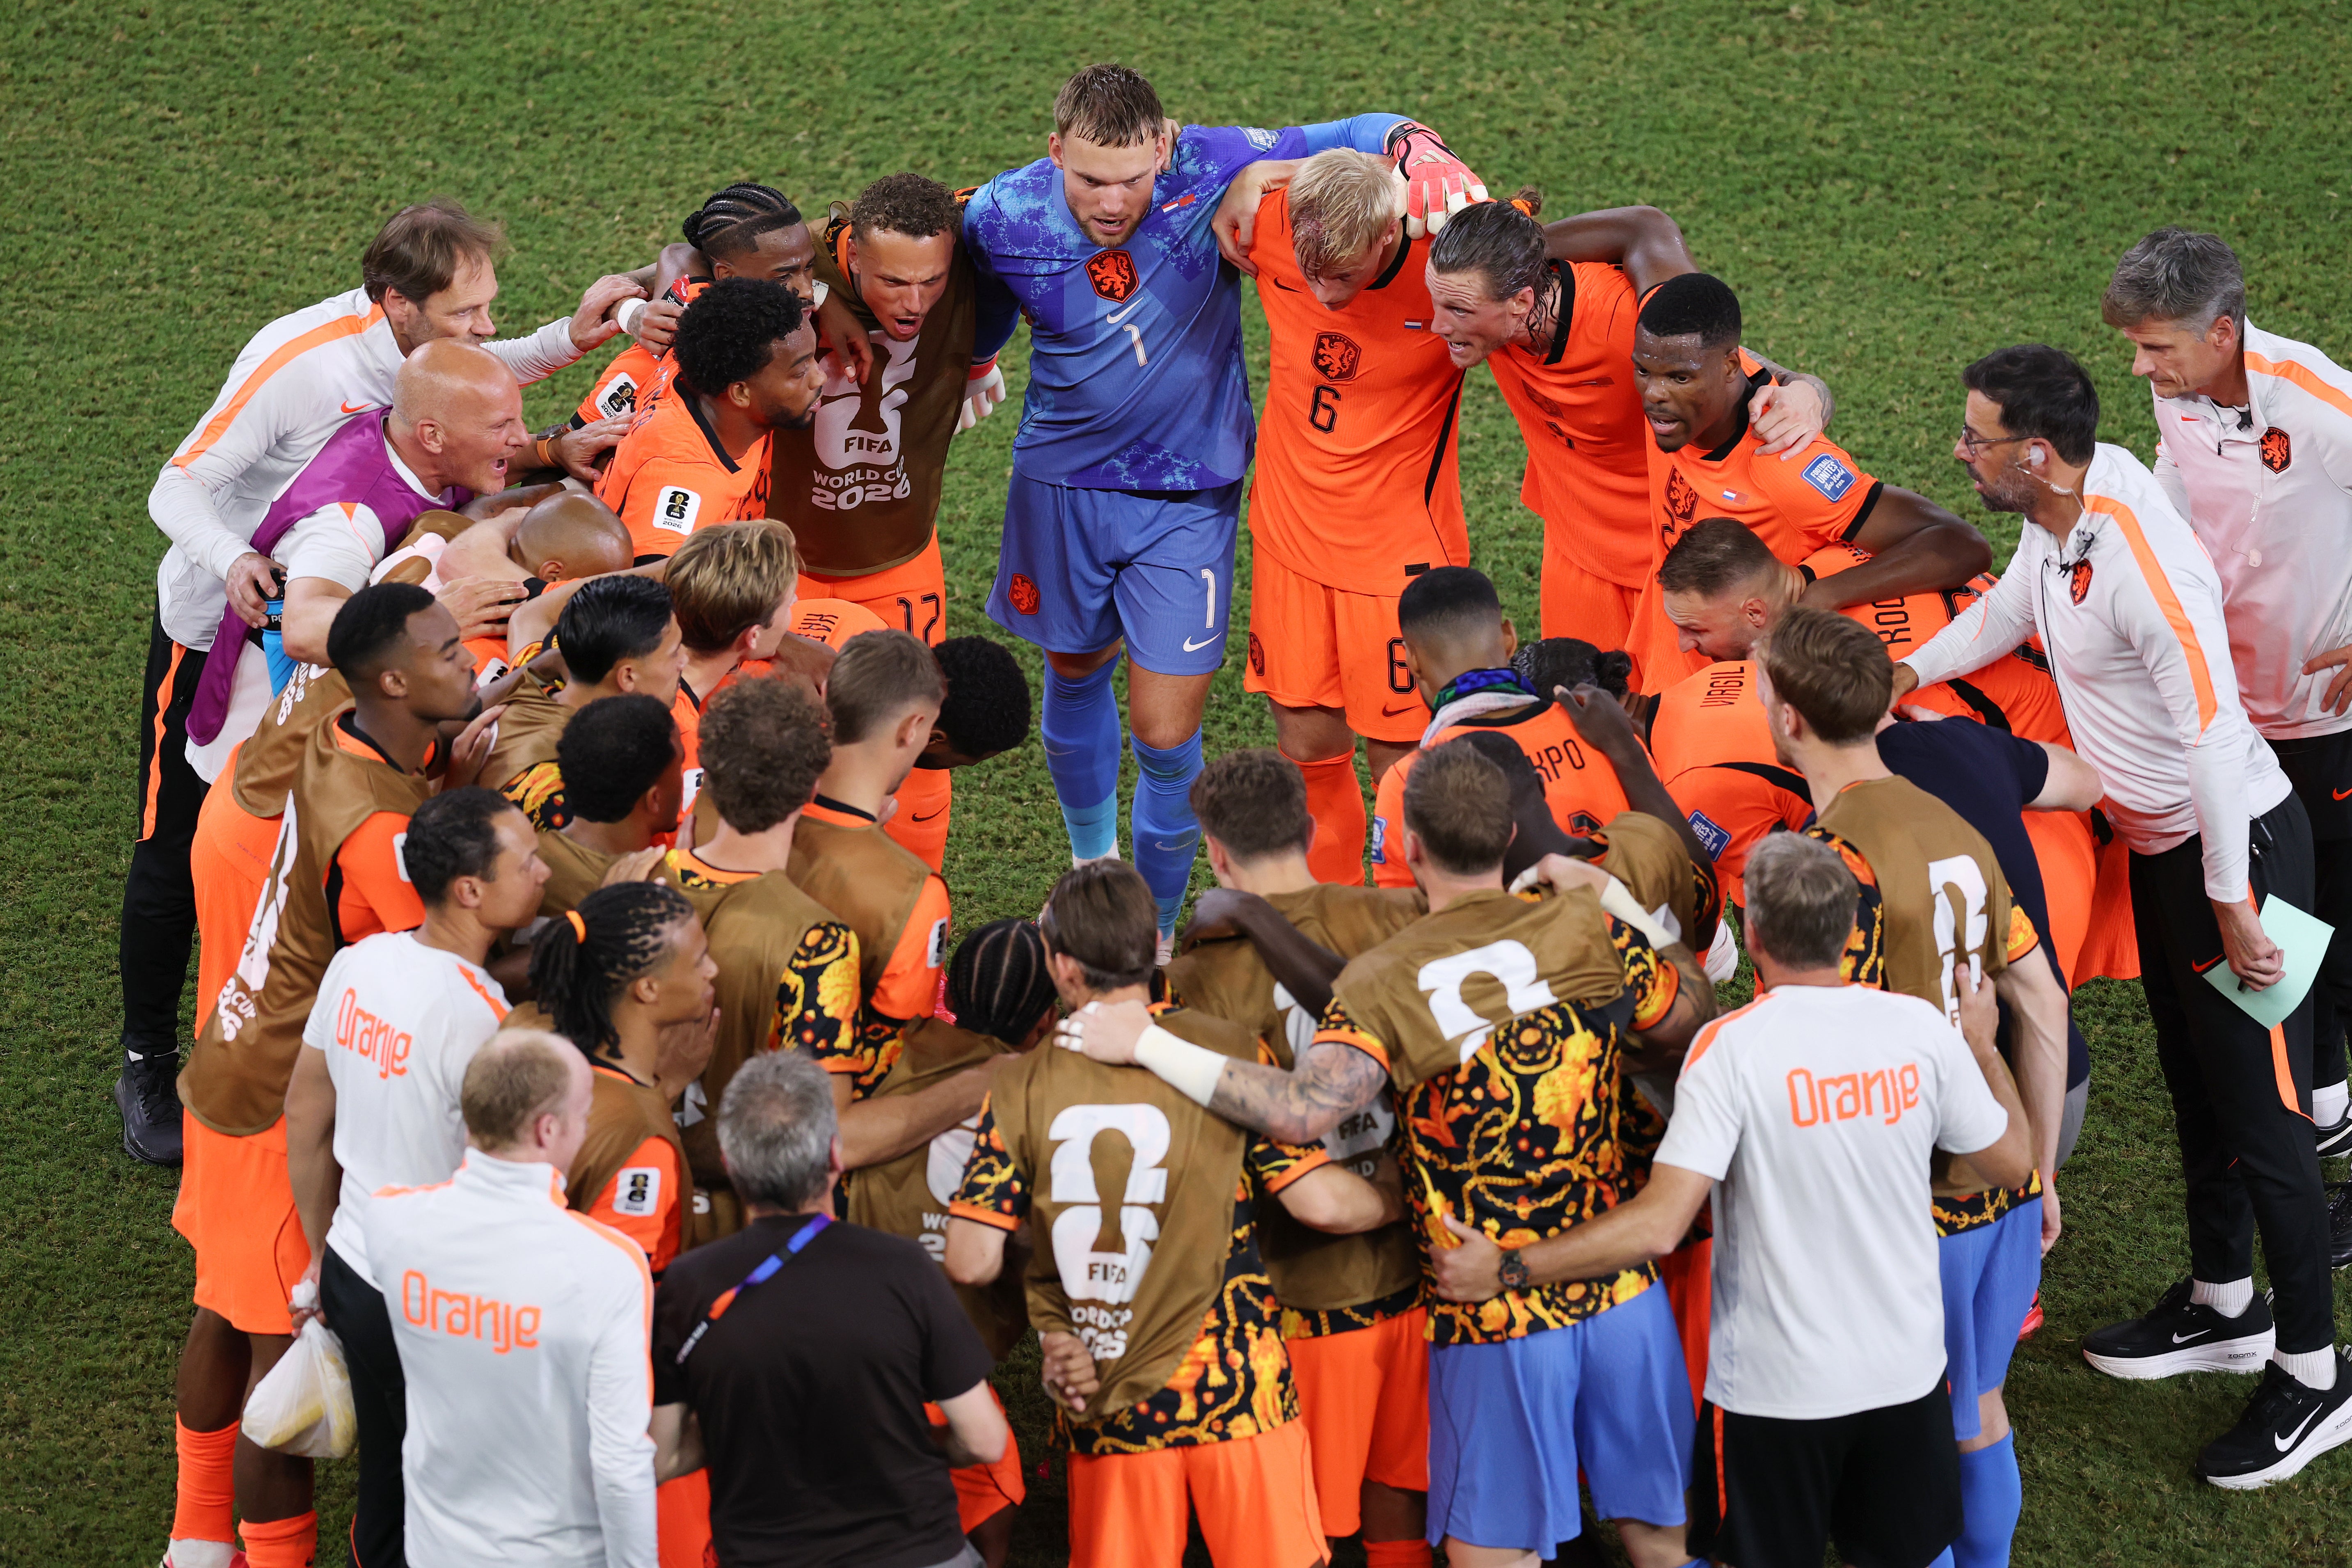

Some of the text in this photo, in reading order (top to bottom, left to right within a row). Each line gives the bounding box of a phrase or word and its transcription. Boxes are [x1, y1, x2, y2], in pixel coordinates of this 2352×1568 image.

[1252, 128, 1267, 146] UNITES
[1122, 323, 1148, 367] 1
[604, 401, 612, 412] WORLD
[611, 400, 619, 409] FIFA
[1308, 384, 1341, 434] 6
[844, 436, 892, 454] FIFA
[813, 454, 905, 489] WORLD CUP
[1810, 458, 1832, 478] FOOTBALL
[1816, 461, 1838, 484] UNITES
[1824, 481, 1834, 491] the
[1835, 479, 1845, 489] FIFA
[811, 472, 911, 511] 2026
[1201, 568, 1216, 628] 1
[897, 592, 940, 648] 17
[1386, 637, 1417, 695] 6
[1700, 666, 1745, 707] VIRGIL
[336, 987, 413, 1080] Oranje
[1786, 1063, 1920, 1128] Oranje
[402, 1269, 542, 1355] Oranje
